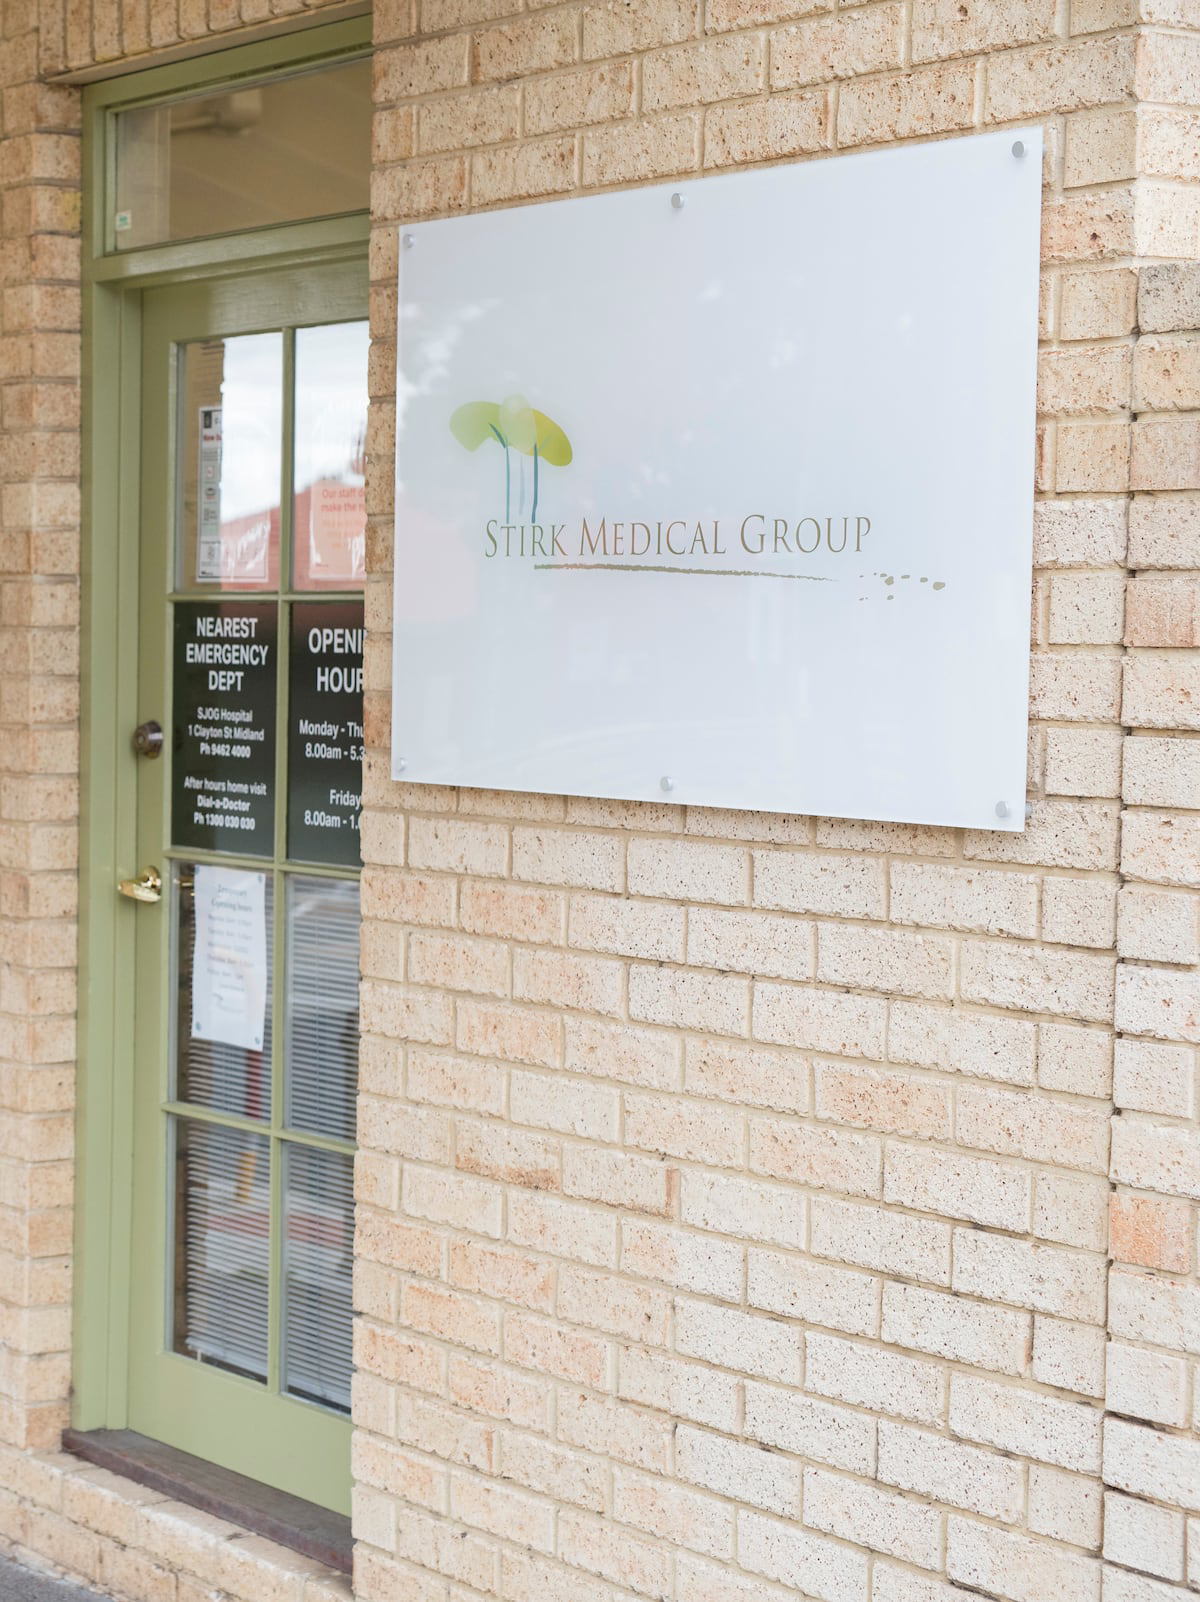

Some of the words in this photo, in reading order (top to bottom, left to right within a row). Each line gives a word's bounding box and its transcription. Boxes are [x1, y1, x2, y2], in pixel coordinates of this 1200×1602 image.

[484, 519, 568, 558] STIRK
[578, 517, 726, 557] MEDICAL
[740, 514, 871, 555] GROUP
[196, 617, 258, 638] NEAREST
[308, 627, 367, 654] OPENI
[186, 643, 269, 666] EMERGENCY
[208, 670, 244, 692] DEPT
[317, 666, 363, 694] HOUR
[197, 706, 219, 721] SJOG
[220, 708, 253, 724] Hospital
[188, 725, 193, 736] 1
[193, 724, 223, 739] Clayton
[224, 726, 232, 739] St
[233, 727, 264, 741] Midland
[299, 719, 339, 740] Monday
[347, 722, 364, 738] Thu
[199, 742, 210, 755] Ph
[211, 743, 230, 757] 9462
[231, 745, 251, 758] 4000
[305, 742, 341, 760] 8.00am
[350, 745, 365, 761] 5.3
[184, 776, 204, 789] After
[204, 777, 226, 792] hours
[227, 779, 249, 794] home
[249, 782, 267, 795] visit
[197, 795, 250, 812] Dial-a-Doctor
[330, 789, 361, 810] Friday
[194, 812, 204, 824] Ph
[206, 813, 223, 827] 1300
[240, 817, 255, 830] 030
[304, 810, 341, 828] 8.00am
